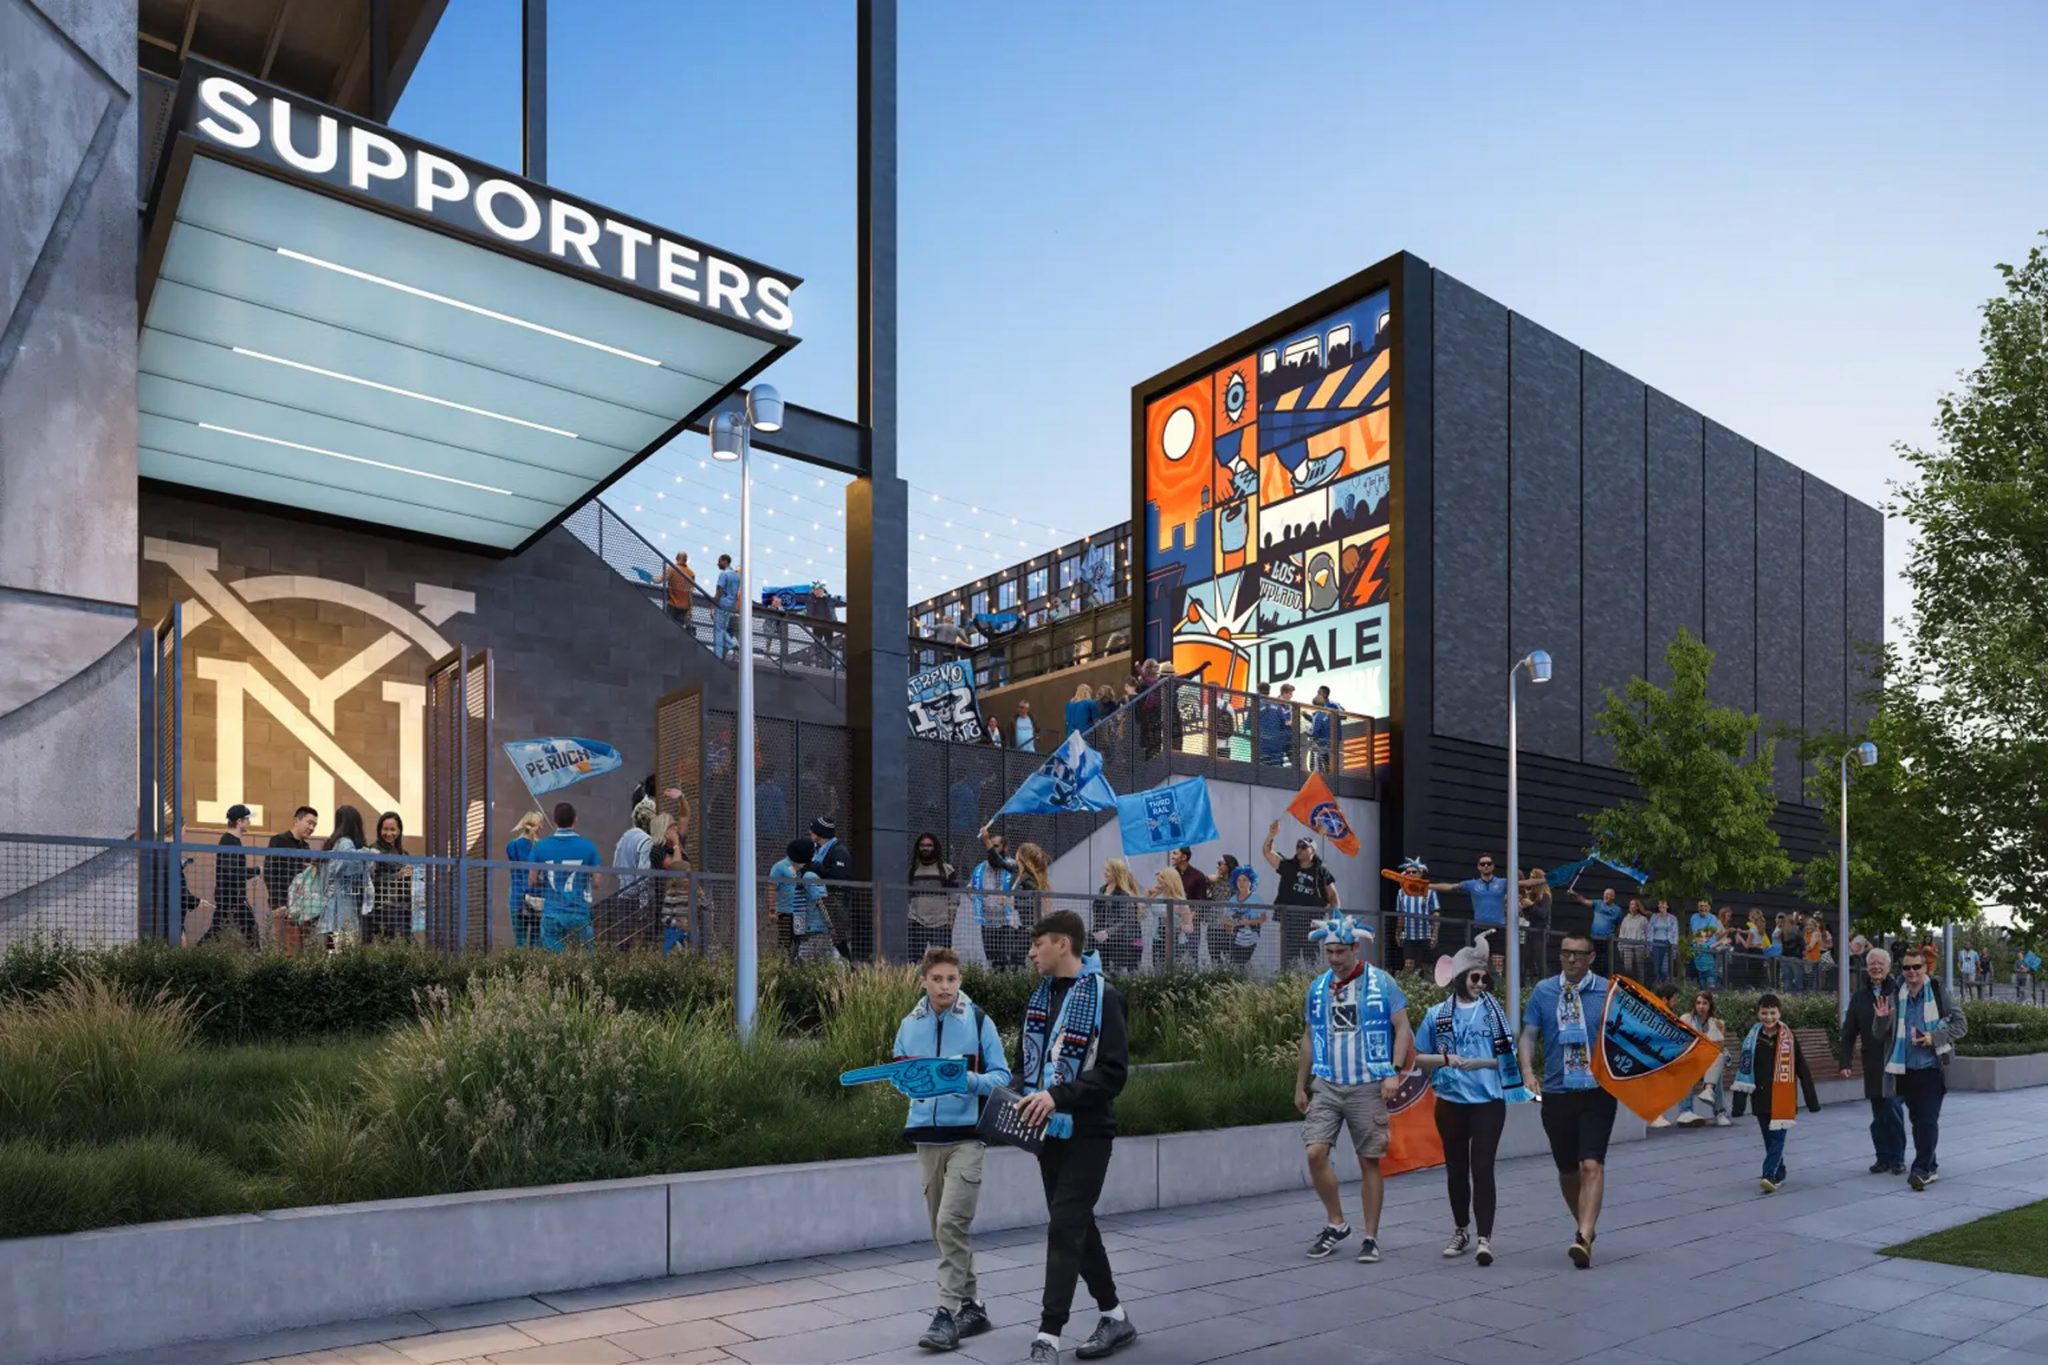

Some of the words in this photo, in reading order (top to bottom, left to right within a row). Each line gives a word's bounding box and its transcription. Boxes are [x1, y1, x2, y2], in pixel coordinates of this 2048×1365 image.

[196, 75, 795, 333] SUPPORTERS
[1270, 560, 1296, 584] LOS
[1268, 616, 1382, 684] DALE
[545, 859, 584, 892] 17
